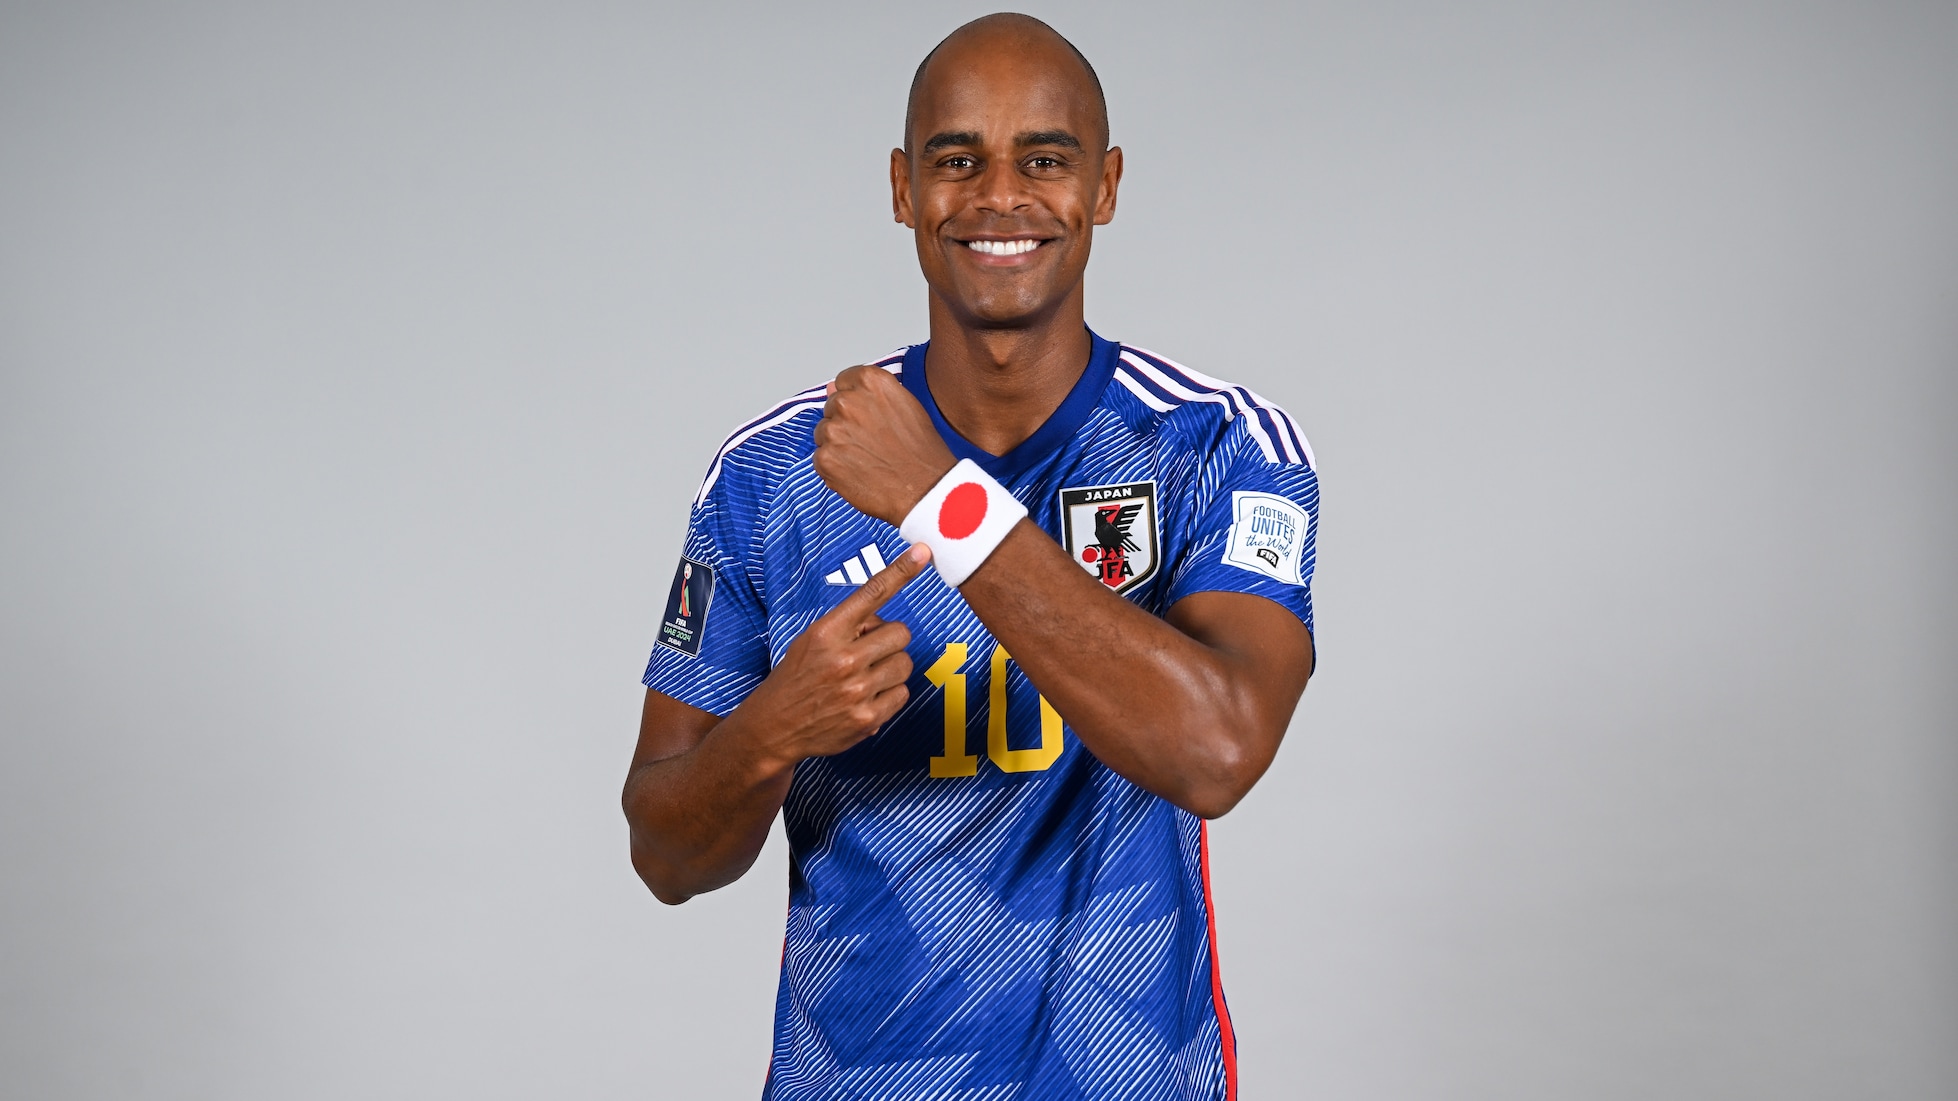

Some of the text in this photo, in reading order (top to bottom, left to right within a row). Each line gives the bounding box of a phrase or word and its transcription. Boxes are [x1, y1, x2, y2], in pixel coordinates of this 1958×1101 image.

[1085, 488, 1132, 501] JAPAN
[1253, 505, 1296, 530] FOOTBALL
[1251, 516, 1295, 545] UNITES
[1245, 534, 1293, 561] the World
[1259, 549, 1279, 567] FIFA
[1096, 561, 1134, 579] JFA
[675, 617, 687, 627] FIFA
[663, 626, 676, 636] UAE
[676, 631, 692, 642] 2024
[924, 643, 1064, 778] 10
